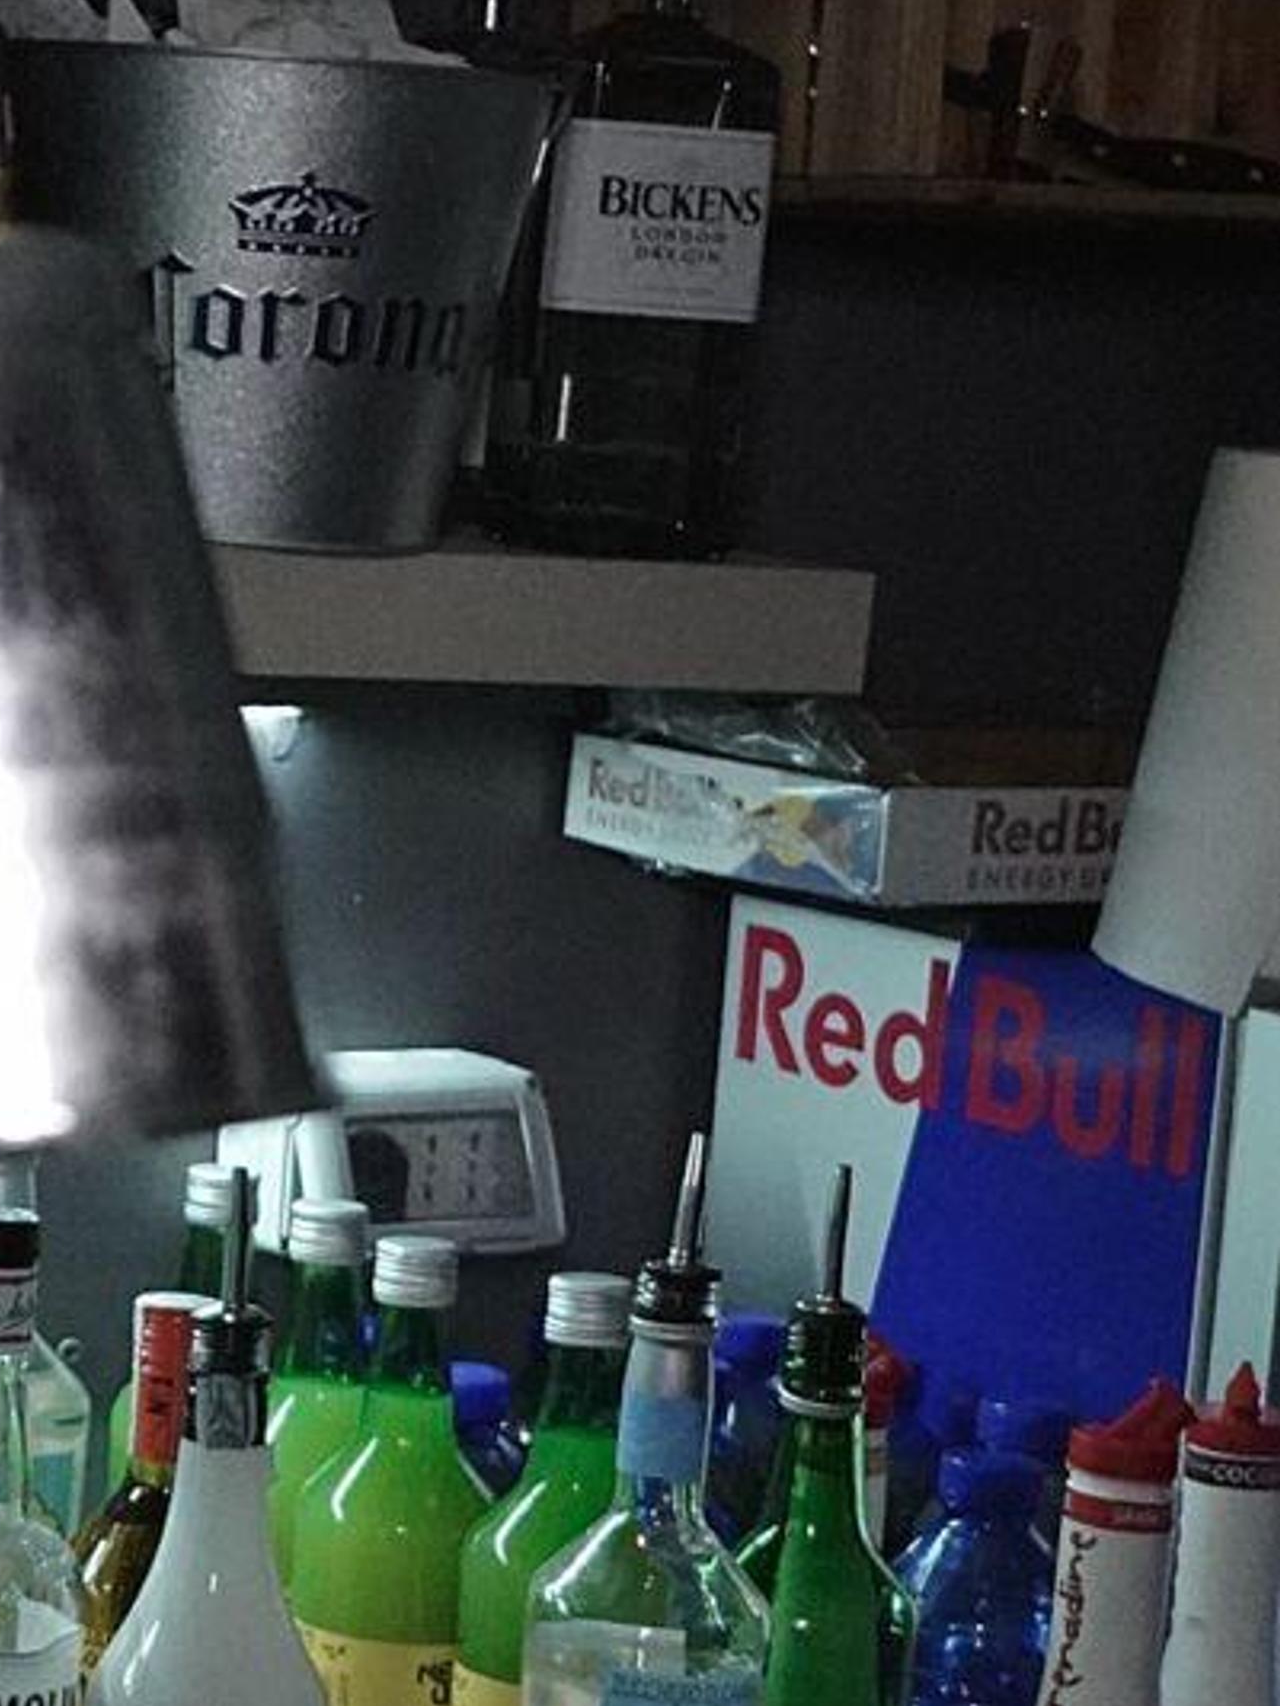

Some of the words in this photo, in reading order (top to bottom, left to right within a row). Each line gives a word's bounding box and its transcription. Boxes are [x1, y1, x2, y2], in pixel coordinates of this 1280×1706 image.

[599, 175, 760, 227] BICKENS
[631, 226, 728, 245] LONDON
[972, 796, 1070, 855] Red
[735, 924, 951, 1110] Red
[965, 975, 1207, 1177] Bull
